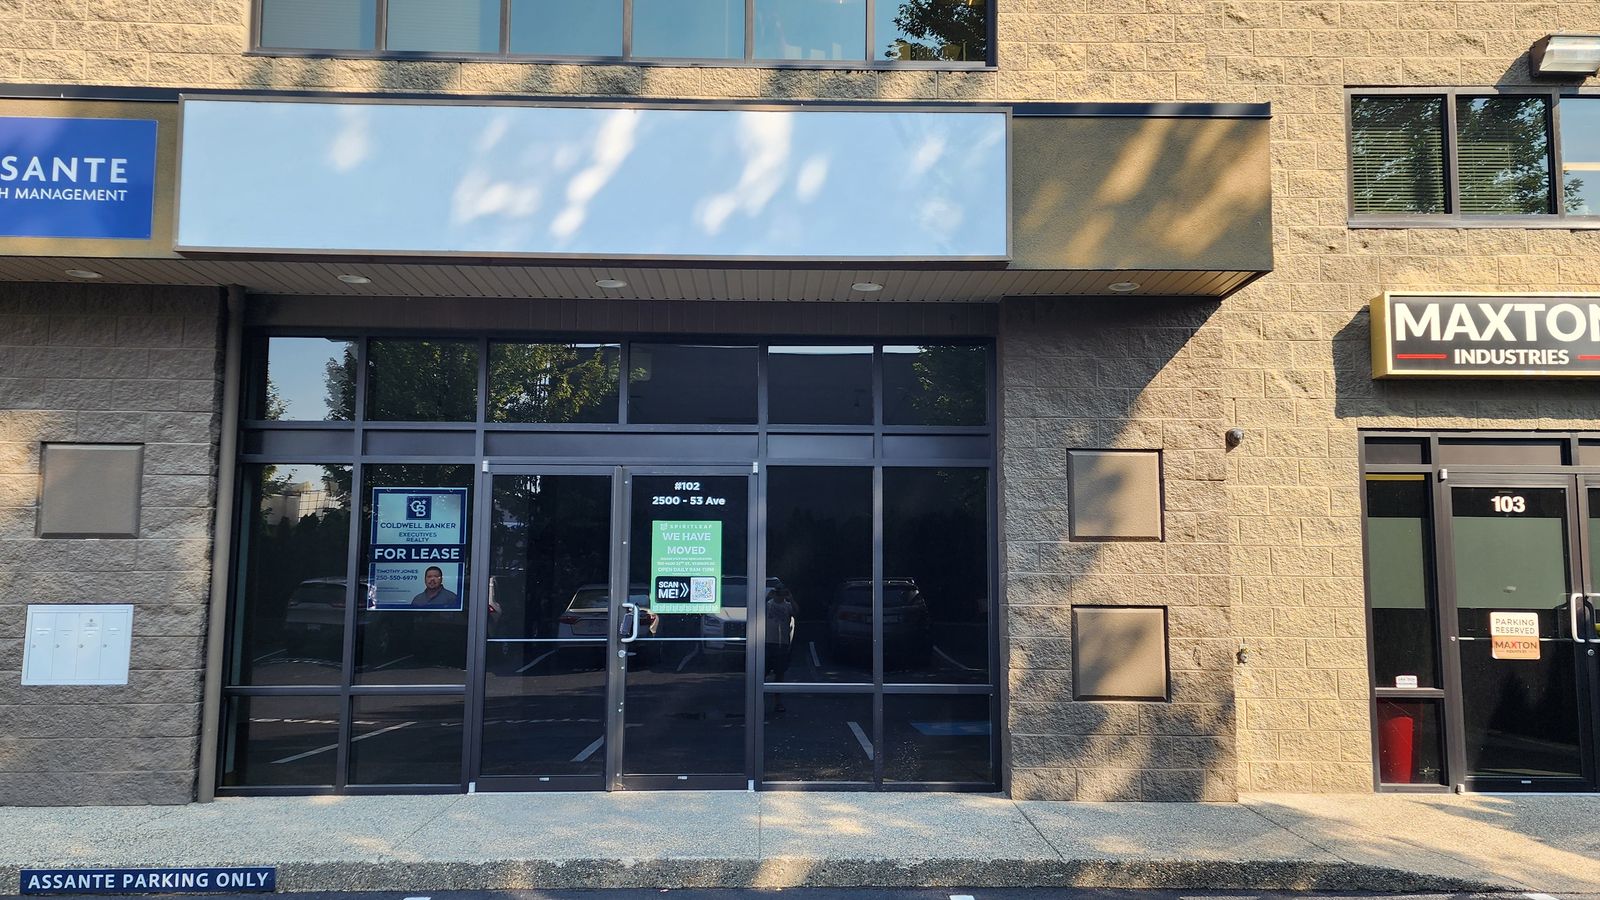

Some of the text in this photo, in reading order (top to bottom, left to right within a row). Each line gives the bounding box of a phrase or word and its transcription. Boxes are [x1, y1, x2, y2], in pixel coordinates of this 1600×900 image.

[15, 188, 128, 201] MANAGEMENT
[1454, 349, 1570, 365] INDUSTRIES
[674, 481, 700, 491] #102
[652, 496, 680, 505] 2500
[690, 496, 703, 505] 53
[705, 496, 726, 505] Ave
[1490, 496, 1526, 513] 103
[662, 532, 711, 541] WE HAVE
[375, 548, 460, 560] FOR LEASE
[667, 546, 706, 555] MOVED
[658, 588, 679, 599] ME!
[1495, 618, 1535, 626] PARKING
[1495, 626, 1536, 634] RESERVED
[1495, 641, 1538, 649] MAXTON
[28, 872, 269, 889] ASSANTE PARKING ONLY
